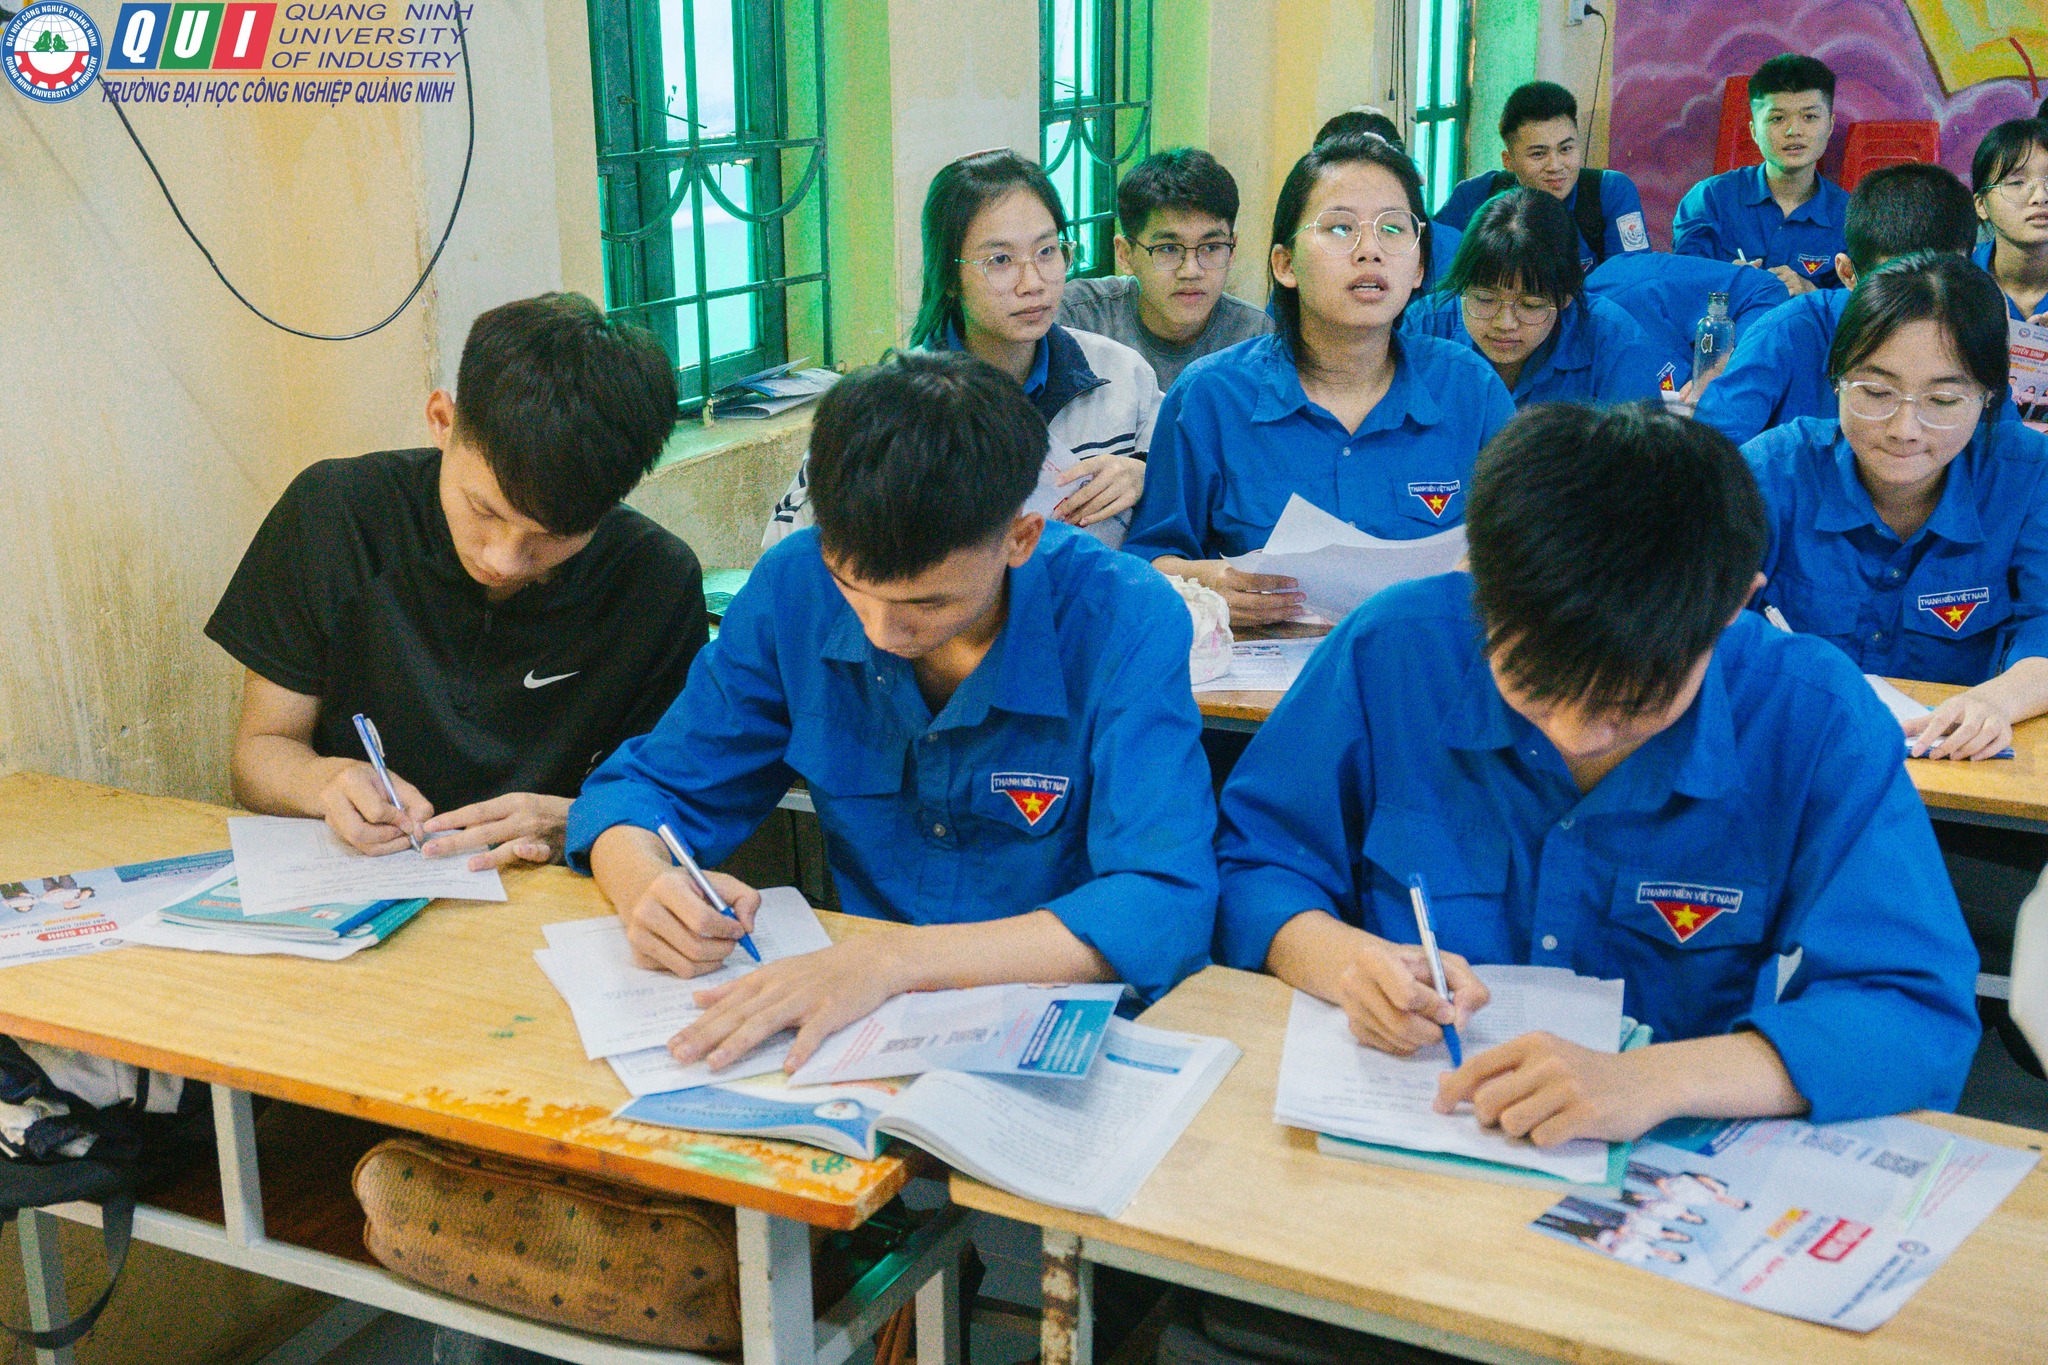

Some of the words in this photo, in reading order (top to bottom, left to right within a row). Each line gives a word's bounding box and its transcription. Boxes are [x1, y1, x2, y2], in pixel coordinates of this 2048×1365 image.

[1921, 597, 1942, 606] THANH
[1956, 592, 1971, 602] VIỆT
[1972, 590, 1987, 600] NAM
[994, 778, 1020, 787] THANH
[1038, 778, 1052, 791] VIỆT
[1641, 888, 1671, 898] THANH
[1694, 889, 1715, 904] VIỆT
[1716, 893, 1739, 905] NAM
